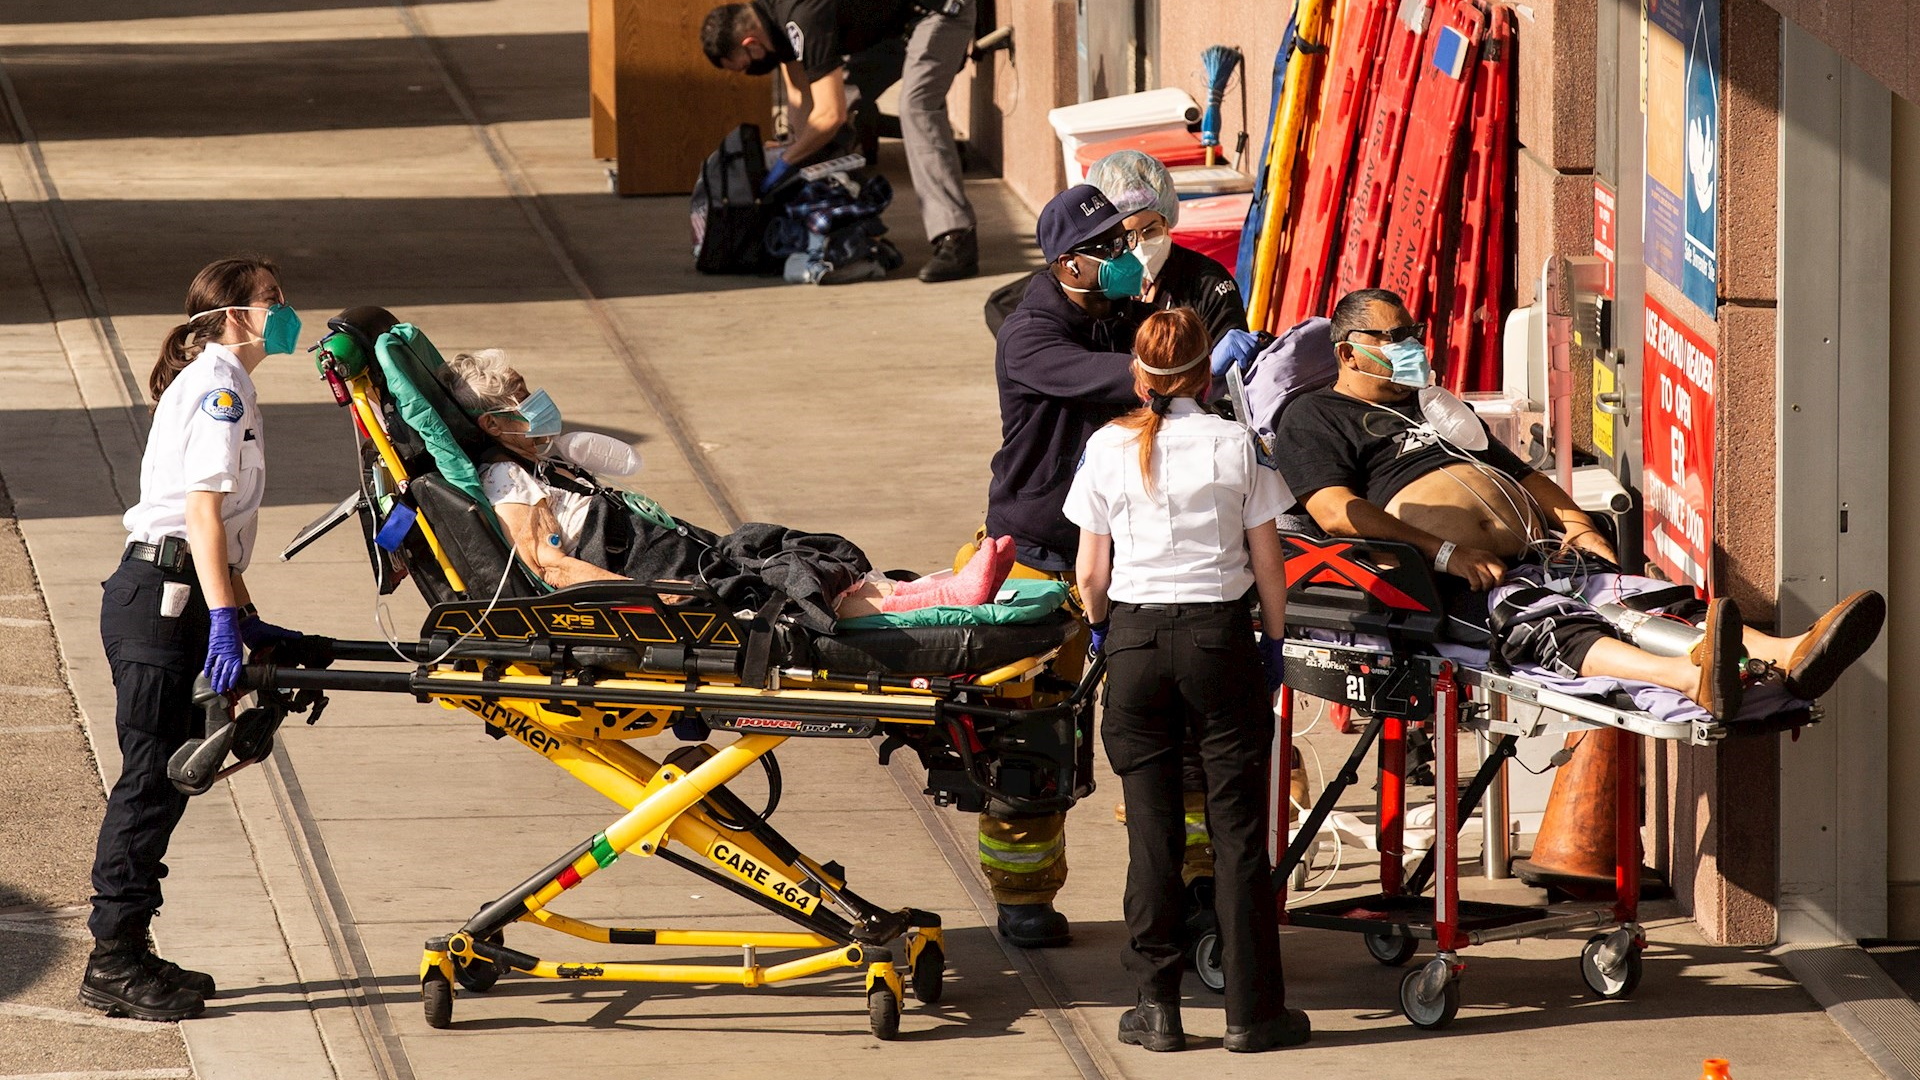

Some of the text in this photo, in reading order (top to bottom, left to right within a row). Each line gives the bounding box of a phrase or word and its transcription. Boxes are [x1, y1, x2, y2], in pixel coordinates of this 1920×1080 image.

[1373, 108, 1387, 148] LOS
[1412, 187, 1429, 230] LOS
[1645, 306, 1659, 350] USE
[1660, 373, 1692, 430] TO OPEN
[1671, 425, 1685, 490] ER
[1649, 471, 1704, 554] ENTRANCE DOOR
[551, 613, 595, 630] XPS
[1345, 674, 1367, 702] 21
[713, 844, 811, 910] CARE 464
